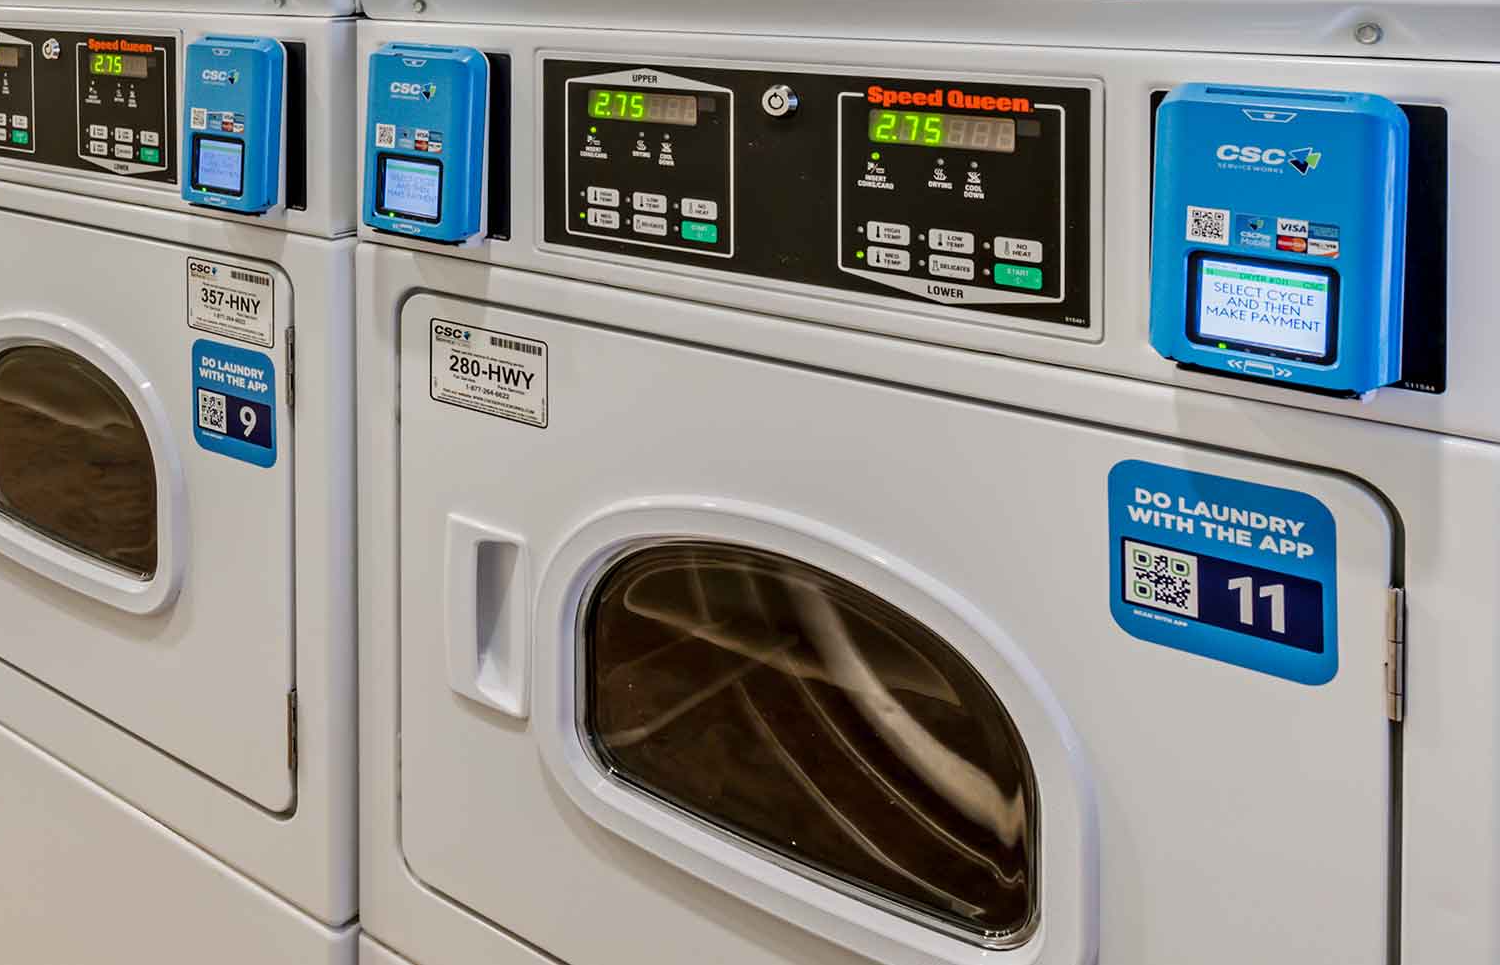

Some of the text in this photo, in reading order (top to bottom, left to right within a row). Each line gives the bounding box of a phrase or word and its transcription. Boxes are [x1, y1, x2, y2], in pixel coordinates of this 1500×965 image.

[88, 38, 153, 52] Speed Queen
[95, 55, 121, 73] 2.75
[202, 70, 227, 81] CSC
[632, 74, 657, 84] UPPER
[390, 82, 421, 95] CSC
[868, 86, 943, 107] Speed
[594, 93, 644, 118] 2.75
[876, 114, 941, 143] 2.75
[1217, 145, 1286, 164] CSC
[865, 174, 886, 182] INSERT
[928, 181, 952, 189] DRYING
[1281, 224, 1306, 232] VISA
[190, 263, 210, 273] CSC
[940, 263, 971, 273] DELICATES
[1007, 268, 1028, 276] START
[201, 288, 260, 314] 357-HNY
[927, 286, 963, 298] LOWER
[1214, 282, 1315, 306] SELECT CYCLE
[1227, 297, 1300, 316] AND THEN
[1206, 305, 1320, 332] MAKE PAYMENT
[435, 325, 462, 338] CSC
[201, 356, 264, 381] DO LAUNDRY
[450, 355, 534, 390] 280-HWY
[199, 367, 268, 392] WITH THE APP
[239, 406, 256, 436] 9
[1135, 488, 1305, 536] DO LAUNDRY
[1127, 505, 1314, 558] WITH THE APP
[1228, 576, 1284, 634] 11
